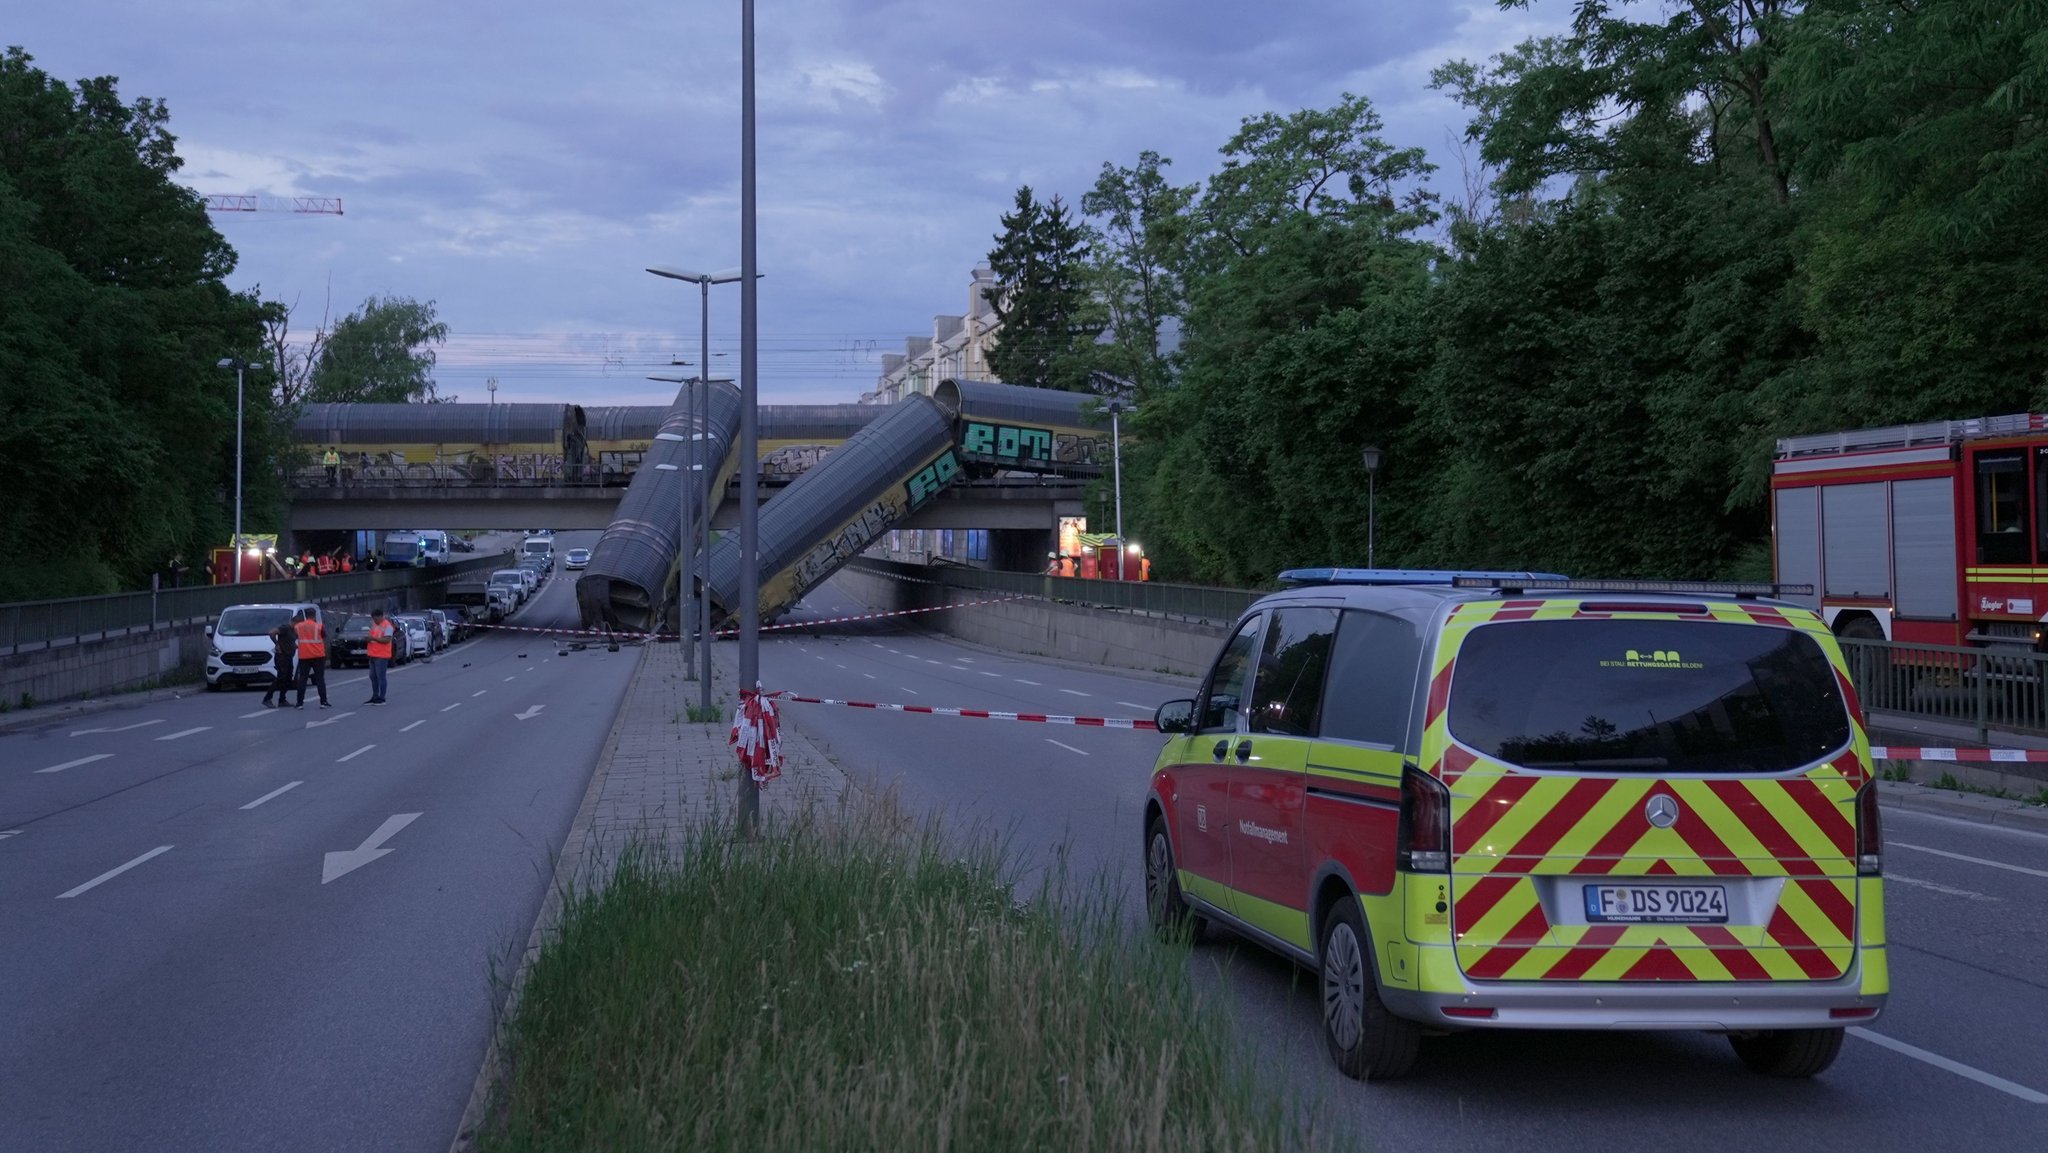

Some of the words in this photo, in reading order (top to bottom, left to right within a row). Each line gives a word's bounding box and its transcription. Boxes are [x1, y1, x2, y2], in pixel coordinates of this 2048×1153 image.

[1239, 819, 1288, 845] Notfallmanagement
[1600, 889, 1614, 912] F
[1631, 889, 1662, 912] DS
[1666, 889, 1723, 913] 9024
